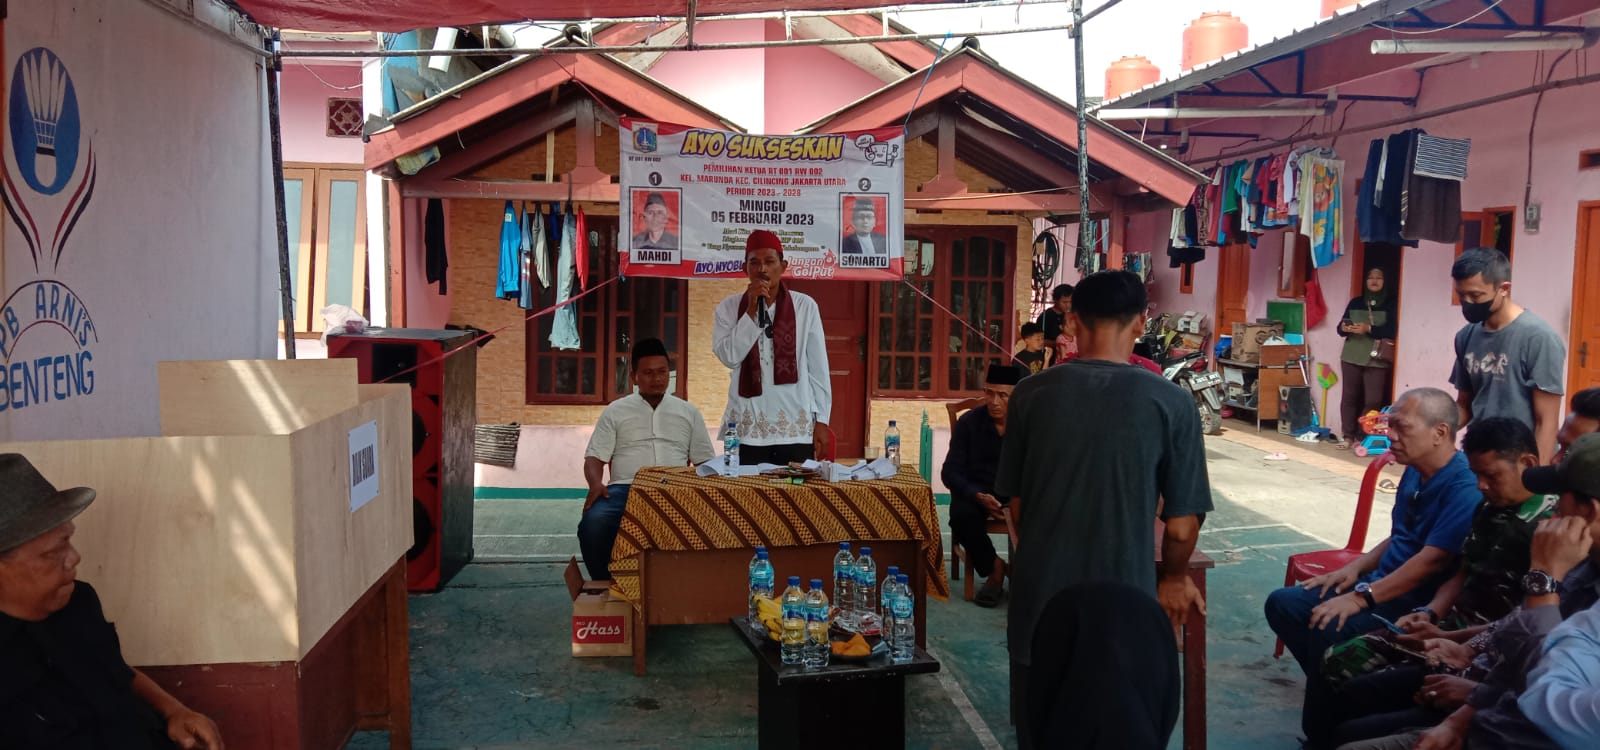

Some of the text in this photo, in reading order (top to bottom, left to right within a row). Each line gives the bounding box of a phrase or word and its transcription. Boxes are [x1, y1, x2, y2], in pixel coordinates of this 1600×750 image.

[680, 130, 845, 161] AYO SUKSESKAN
[703, 164, 743, 173] PEMILIHAN
[744, 166, 767, 175] KETUA
[768, 167, 777, 175] RT
[809, 168, 823, 176] 002
[680, 174, 694, 183] KEL.
[697, 175, 733, 184] MARUNDA
[752, 178, 788, 186] CILINCING
[790, 178, 822, 186] JAKARTA
[726, 187, 755, 196] PERIODE
[757, 188, 776, 196] 2023
[739, 200, 786, 213] MINGGU
[711, 211, 814, 226] 05 FEBRUARI 2023
[638, 251, 672, 262] MAHDI
[787, 256, 823, 270] Jangan
[695, 261, 714, 273] AYO
[792, 266, 834, 279] GolPut
[36, 284, 91, 346] ARNI'S
[0, 350, 94, 412] BENTENG
[576, 621, 621, 640] Hass
